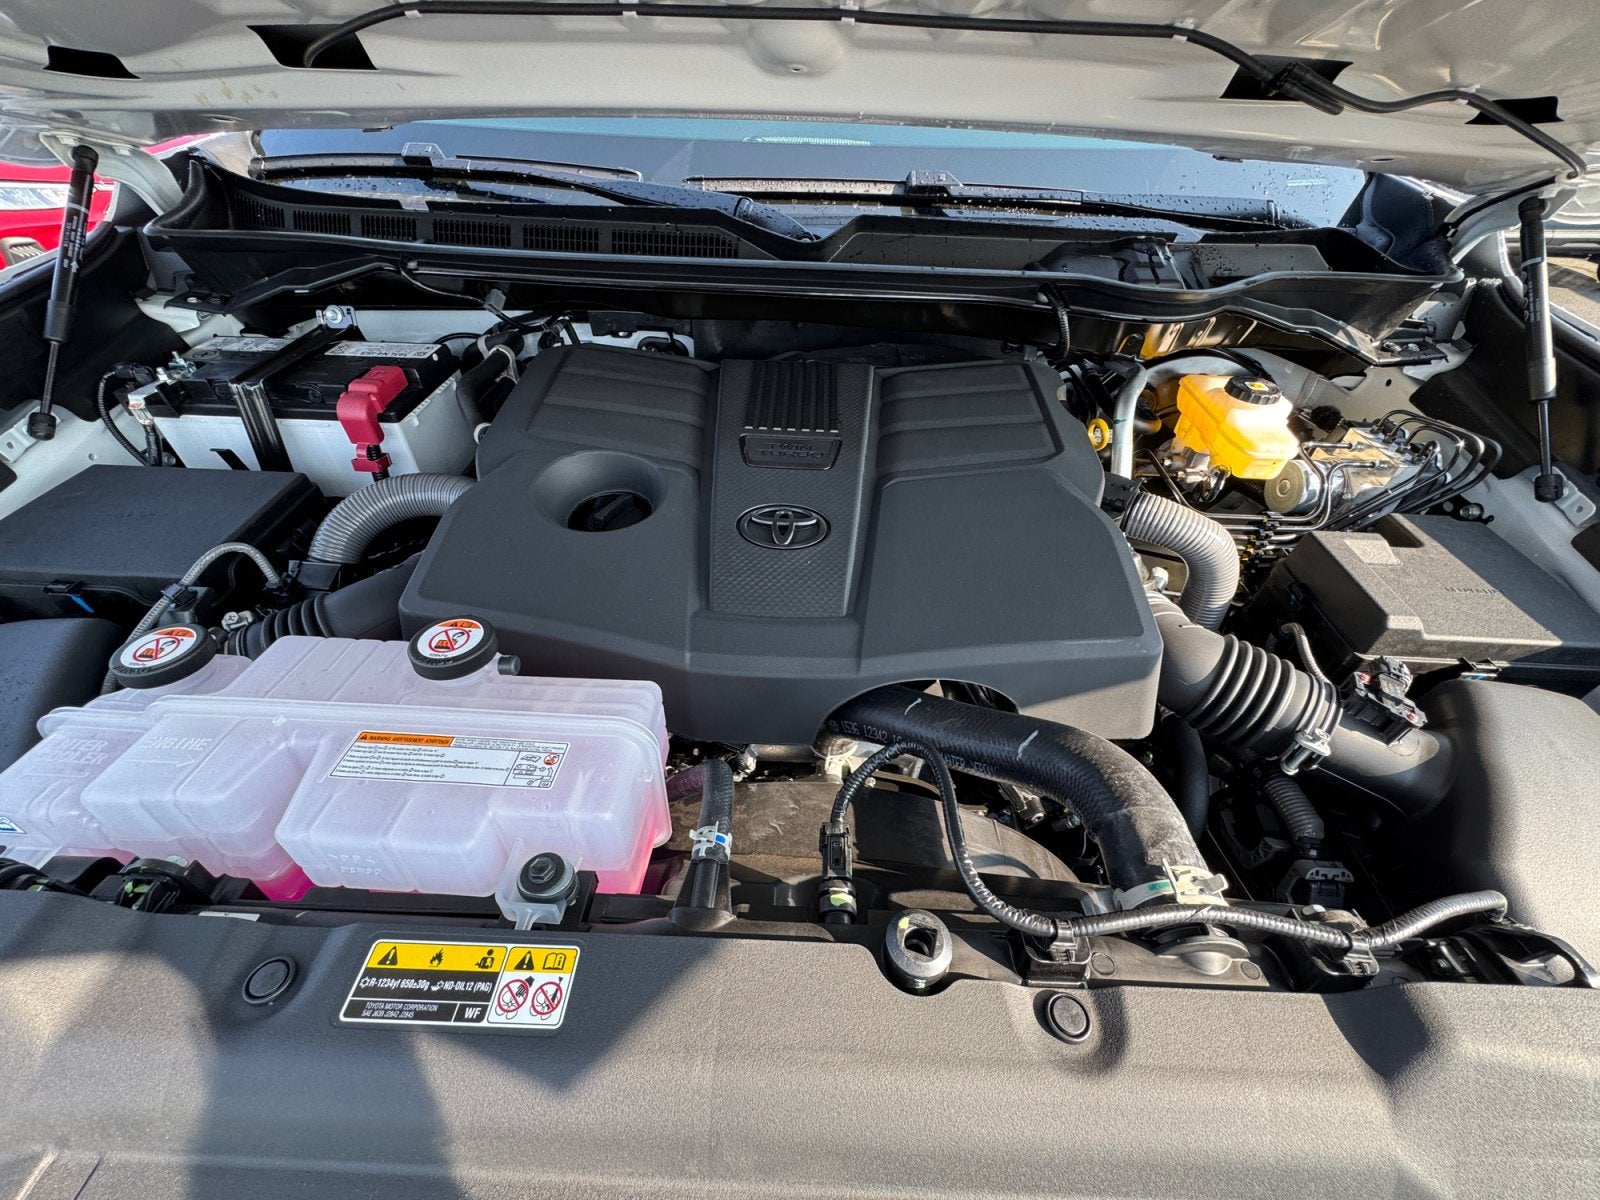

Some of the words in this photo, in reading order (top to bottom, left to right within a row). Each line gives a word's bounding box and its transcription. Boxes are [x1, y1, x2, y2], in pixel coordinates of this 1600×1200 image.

[764, 442, 814, 451] TWIN
[756, 449, 824, 459] TURBO
[144, 735, 212, 751] ENGINE
[369, 977, 402, 990] R-1234yf
[473, 981, 493, 993] (PAG)
[402, 1003, 439, 1012] CORPORATION
[361, 1009, 372, 1017] SAE
[465, 1007, 482, 1019] WF
